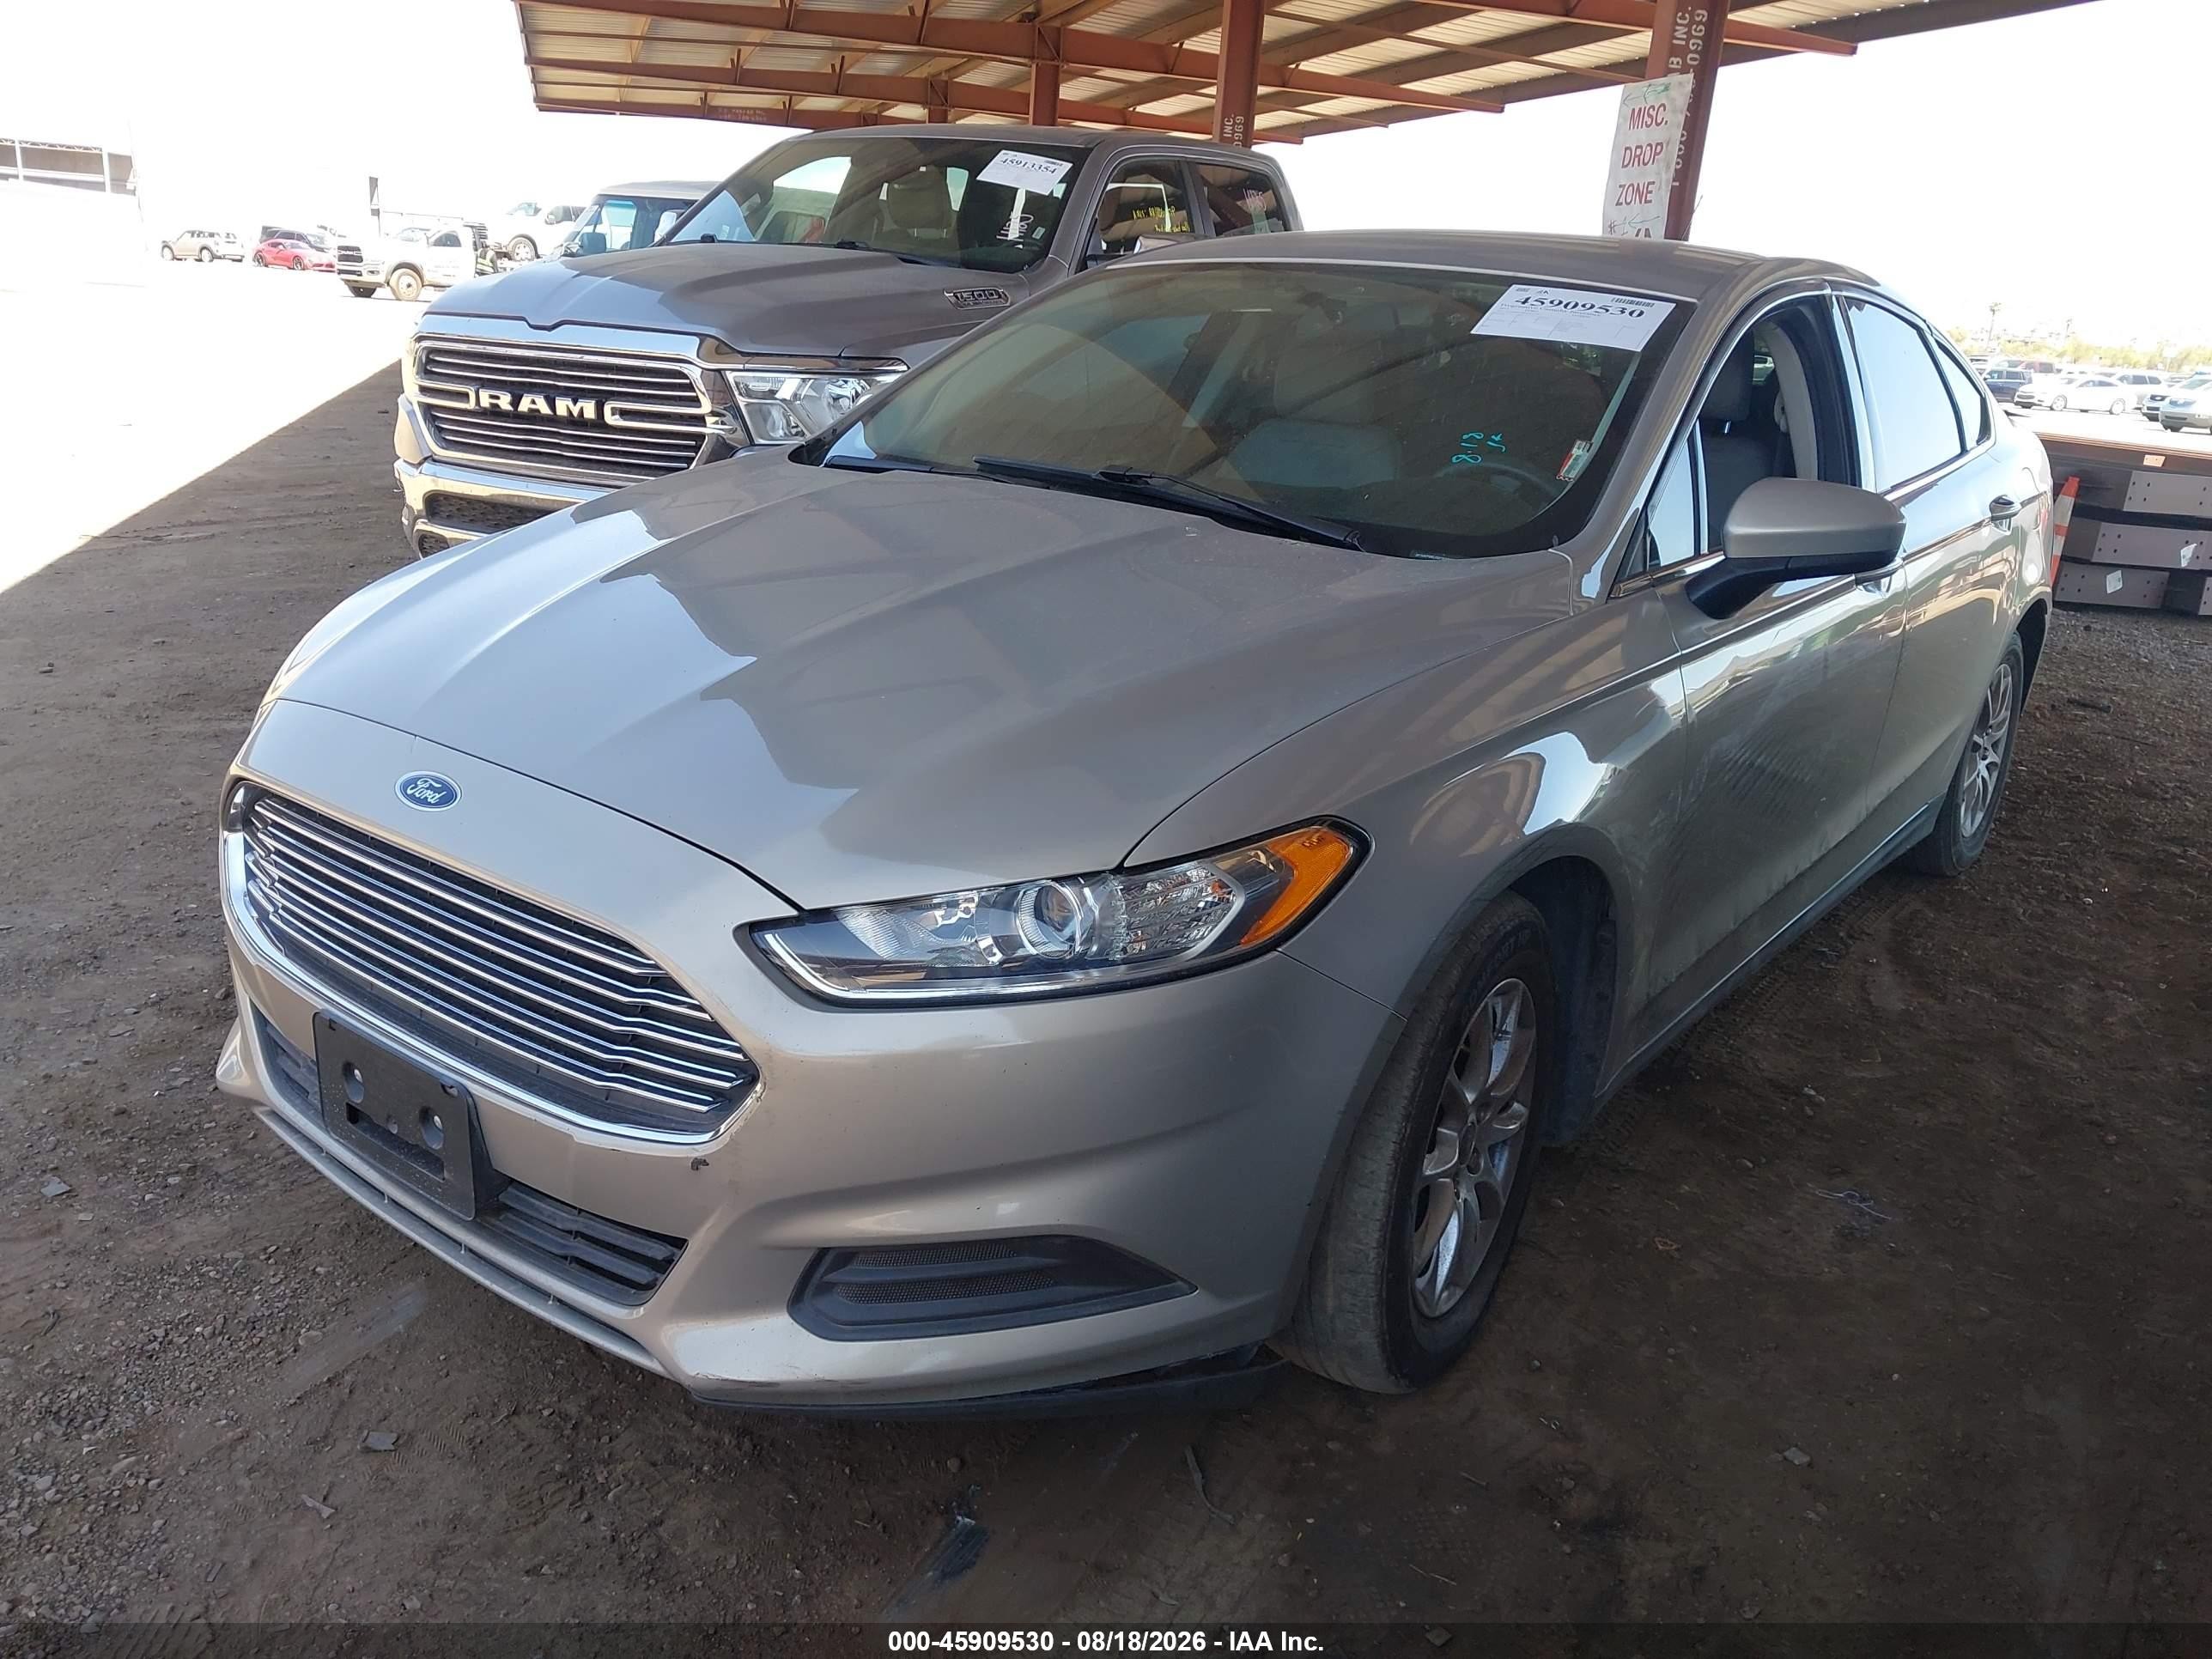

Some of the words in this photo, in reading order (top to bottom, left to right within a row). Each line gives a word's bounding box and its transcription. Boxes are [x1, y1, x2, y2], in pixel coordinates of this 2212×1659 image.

[1673, 6, 1690, 46] INC.
[1223, 113, 1234, 137] INC.
[1629, 102, 1668, 131] MISC.
[1000, 157, 1057, 174] 45913354
[1621, 141, 1664, 169] DROP
[1615, 180, 1656, 207] ZONE
[955, 289, 999, 301] 1500
[1515, 295, 1645, 319] 45909530
[478, 387, 597, 421] RAM
[406, 777, 447, 804] Ford
